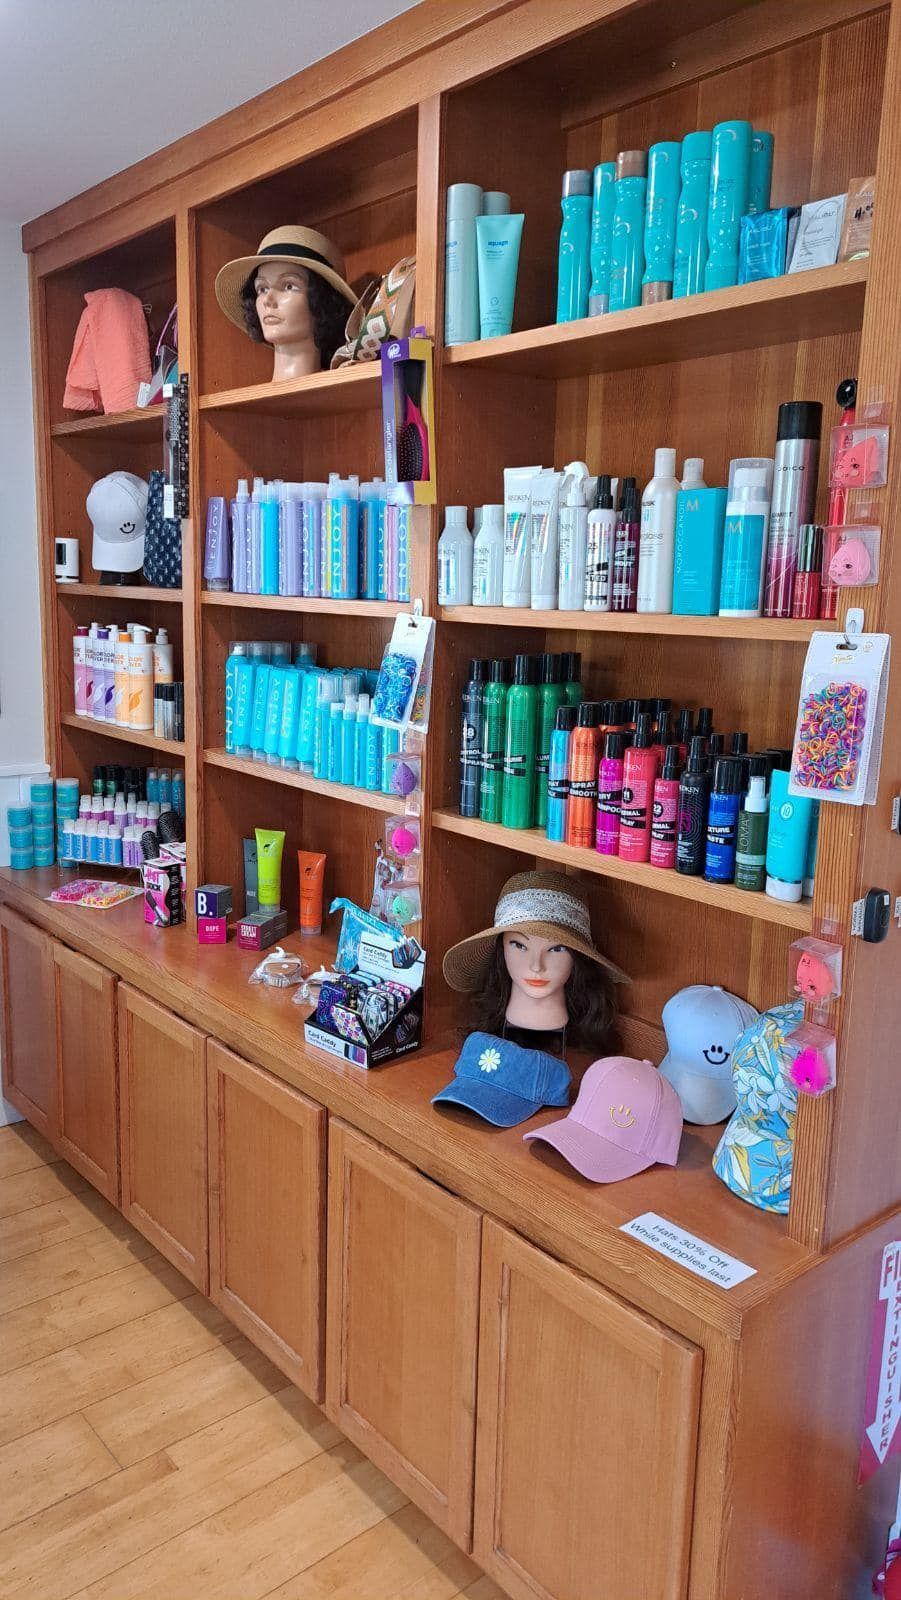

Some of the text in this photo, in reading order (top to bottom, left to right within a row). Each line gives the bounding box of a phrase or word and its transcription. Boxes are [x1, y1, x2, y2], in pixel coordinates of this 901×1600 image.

[384, 421, 394, 464] detangler
[686, 498, 699, 512] M
[728, 519, 743, 534] M
[209, 505, 219, 560] ENJOY
[333, 504, 341, 593] ENJOY
[238, 672, 248, 728] ENJOY
[367, 735, 376, 786] ENJOY
[569, 788, 598, 797] SMOOTH
[740, 819, 750, 853] LOMA
[197, 892, 213, 916] B.
[630, 1222, 732, 1283] While supplies last
[652, 1225, 730, 1270] Hats 30% Off
[883, 1250, 901, 1288] FI
